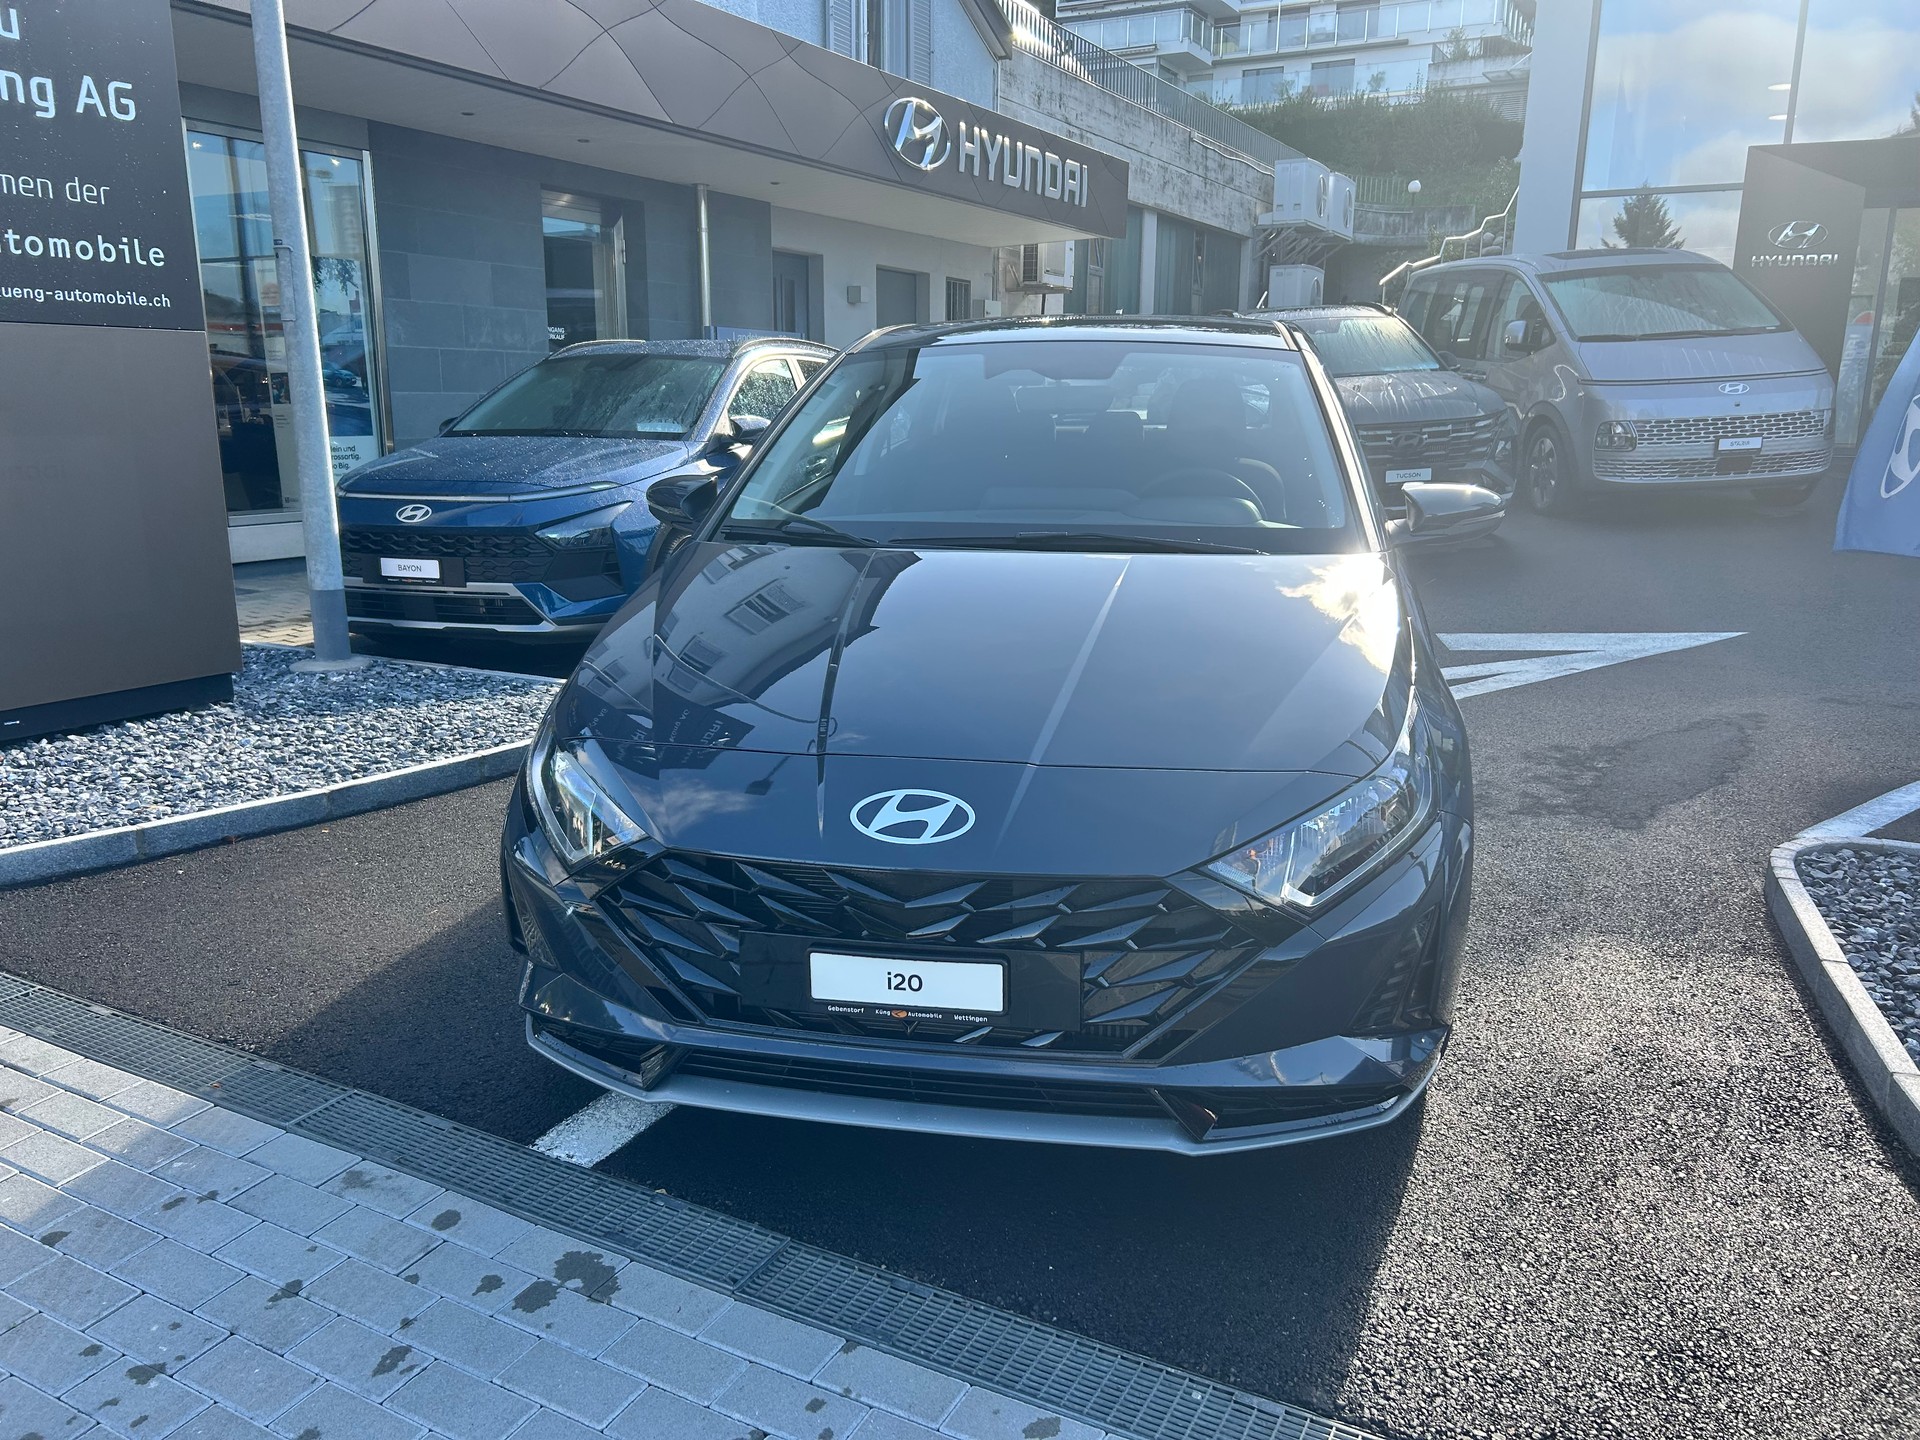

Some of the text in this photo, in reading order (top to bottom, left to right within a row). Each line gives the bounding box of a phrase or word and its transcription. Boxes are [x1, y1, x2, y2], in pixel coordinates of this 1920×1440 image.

[76, 75, 136, 122] AG
[959, 121, 1088, 208] HYUNDAI
[66, 177, 110, 205] der
[0, 229, 165, 267] tomobile
[1751, 253, 1839, 268] HYUNDAI
[0, 286, 171, 309] ueng-automobile.ch
[397, 564, 422, 572] BAYON
[886, 972, 923, 992] i20
[827, 1005, 988, 1023] Gebenstorf Küng Automobile Wettingen
